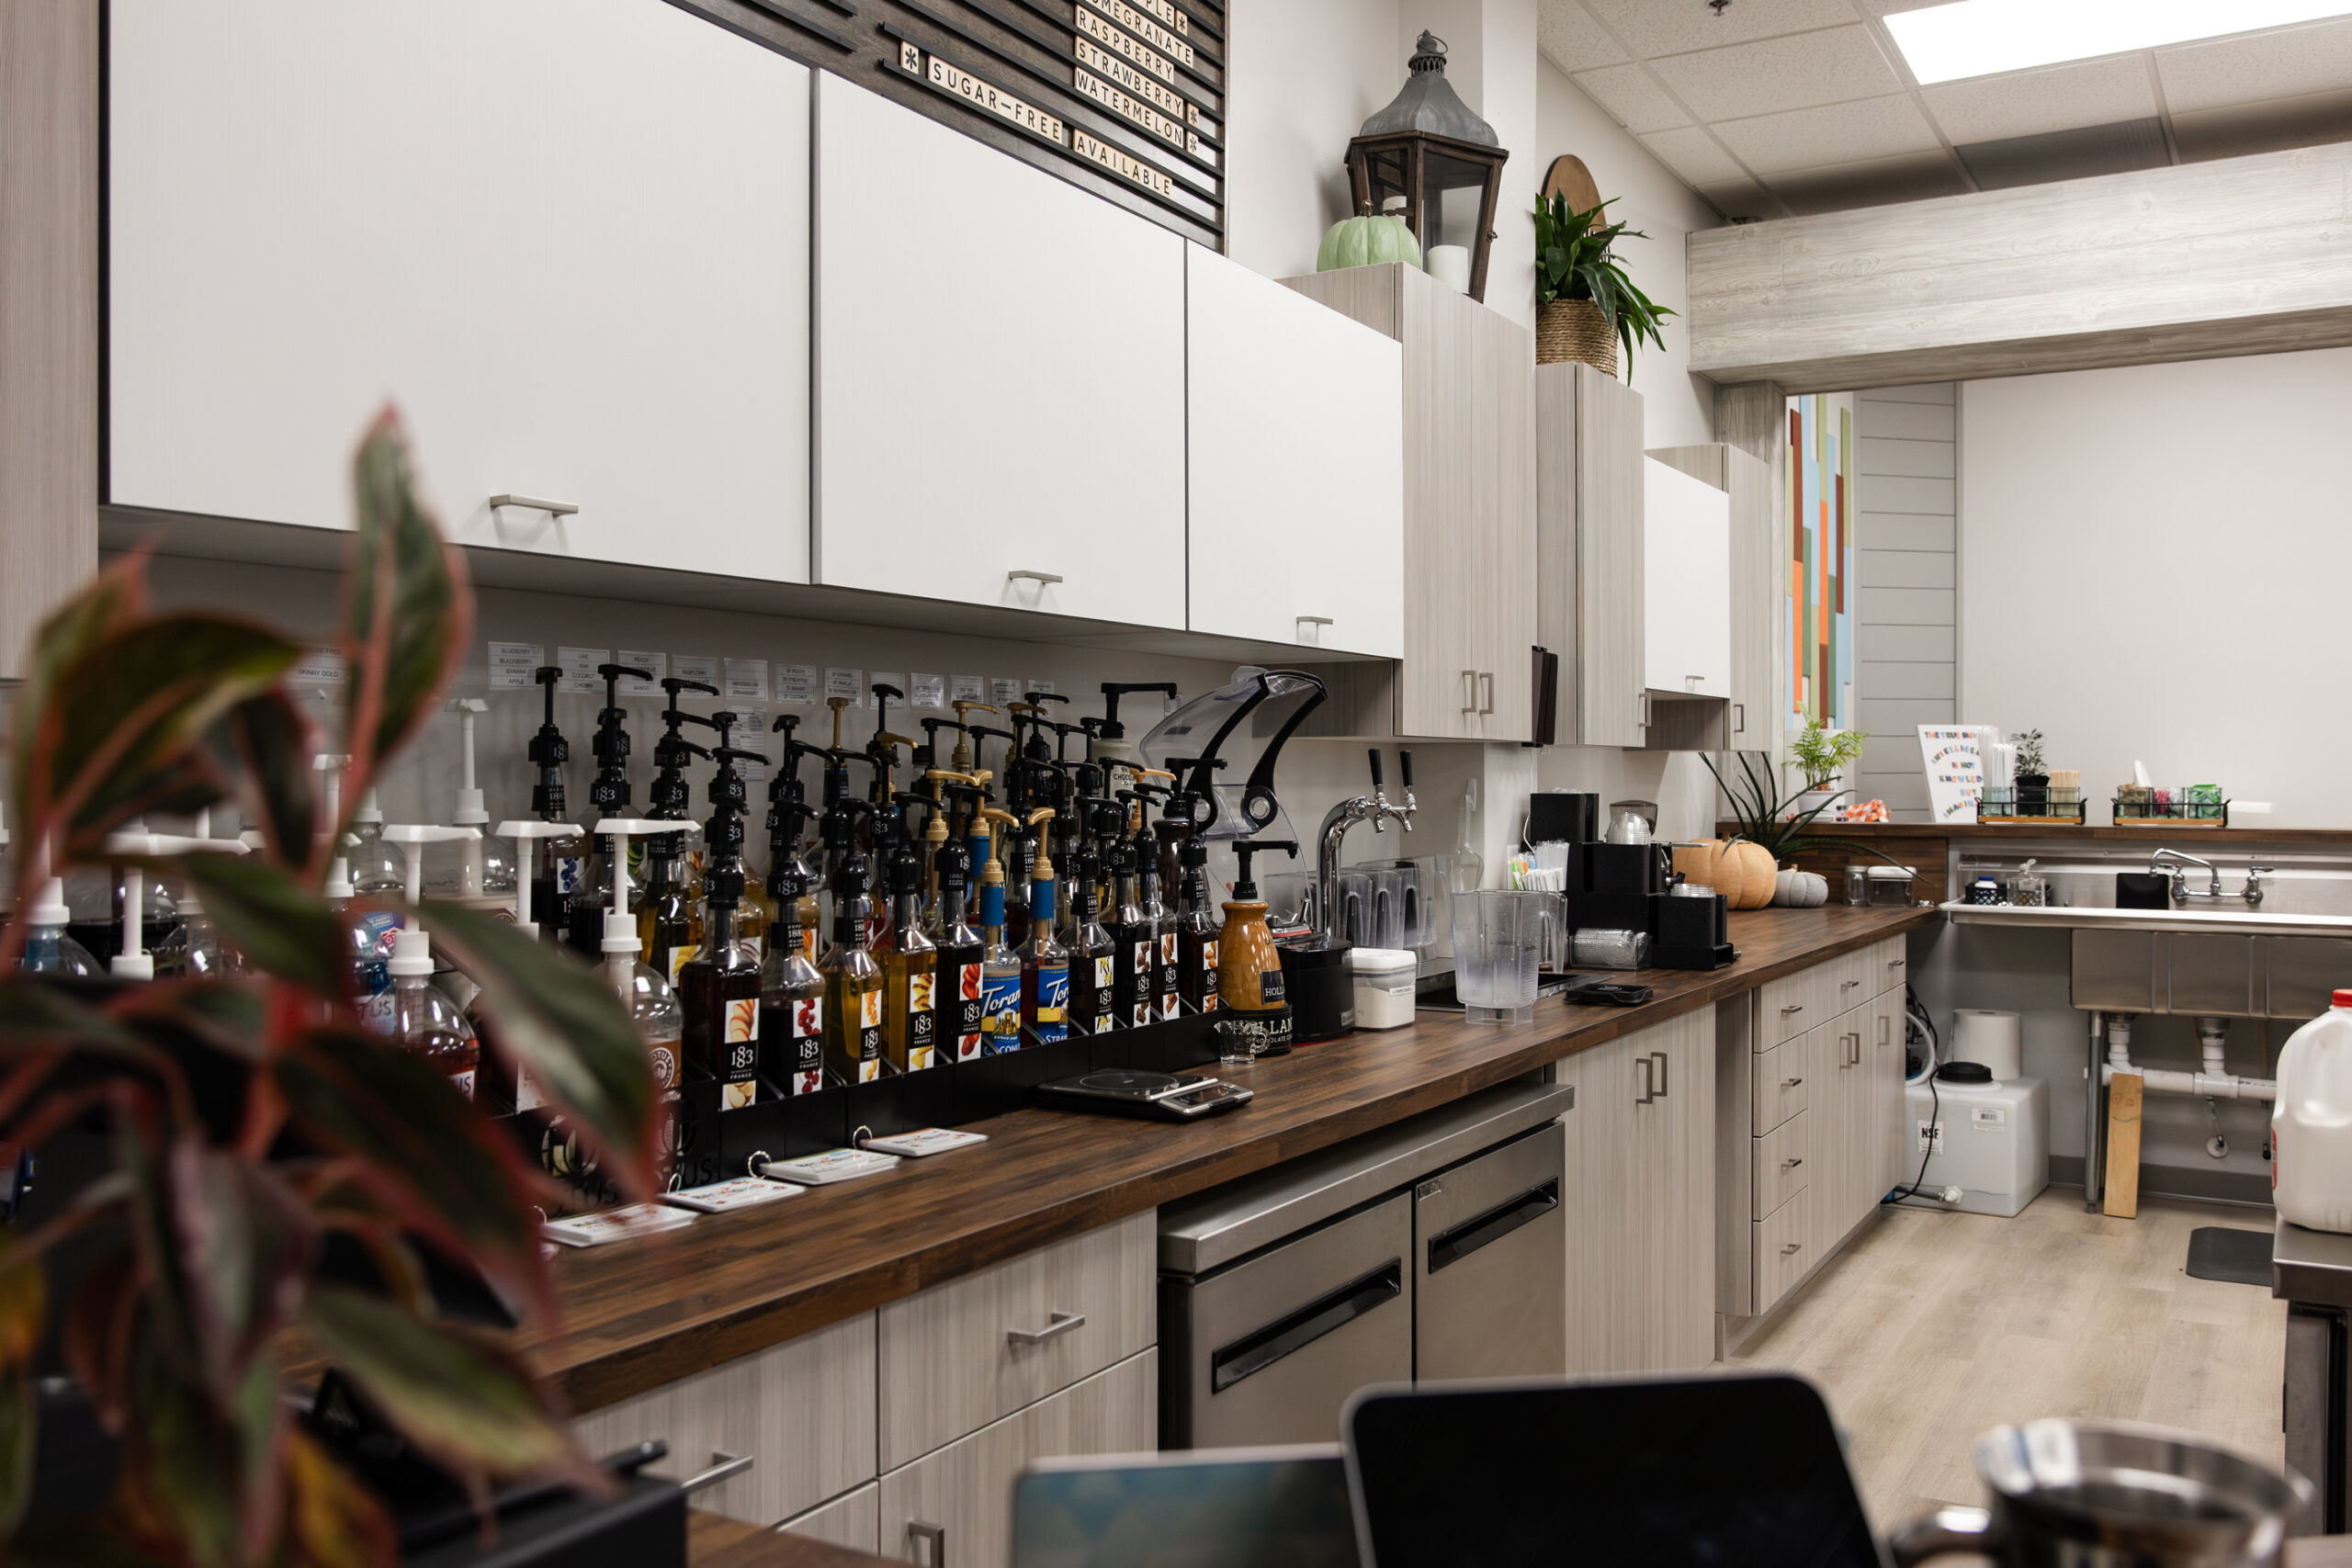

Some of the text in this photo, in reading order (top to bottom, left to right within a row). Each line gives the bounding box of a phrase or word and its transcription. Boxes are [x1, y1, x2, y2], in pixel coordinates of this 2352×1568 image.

[1092, 0, 1192, 64] MEGRANATE
[1080, 10, 1173, 80] RASPBERRY
[1079, 42, 1182, 115] STRAWBERRY
[1077, 71, 1182, 145] WATERMELON
[933, 62, 1170, 195] SUGAR-FREE AVAILABLE
[1137, 976, 1150, 992] 1883
[1165, 966, 1177, 984] 1883
[1099, 988, 1112, 1005] 1883
[964, 1002, 980, 1022] 1883
[914, 1014, 932, 1035] 1883
[798, 1039, 819, 1059] 1883
[865, 1029, 879, 1049] 1883
[730, 1045, 754, 1068] 1883
[729, 1072, 752, 1080] FRANCE
